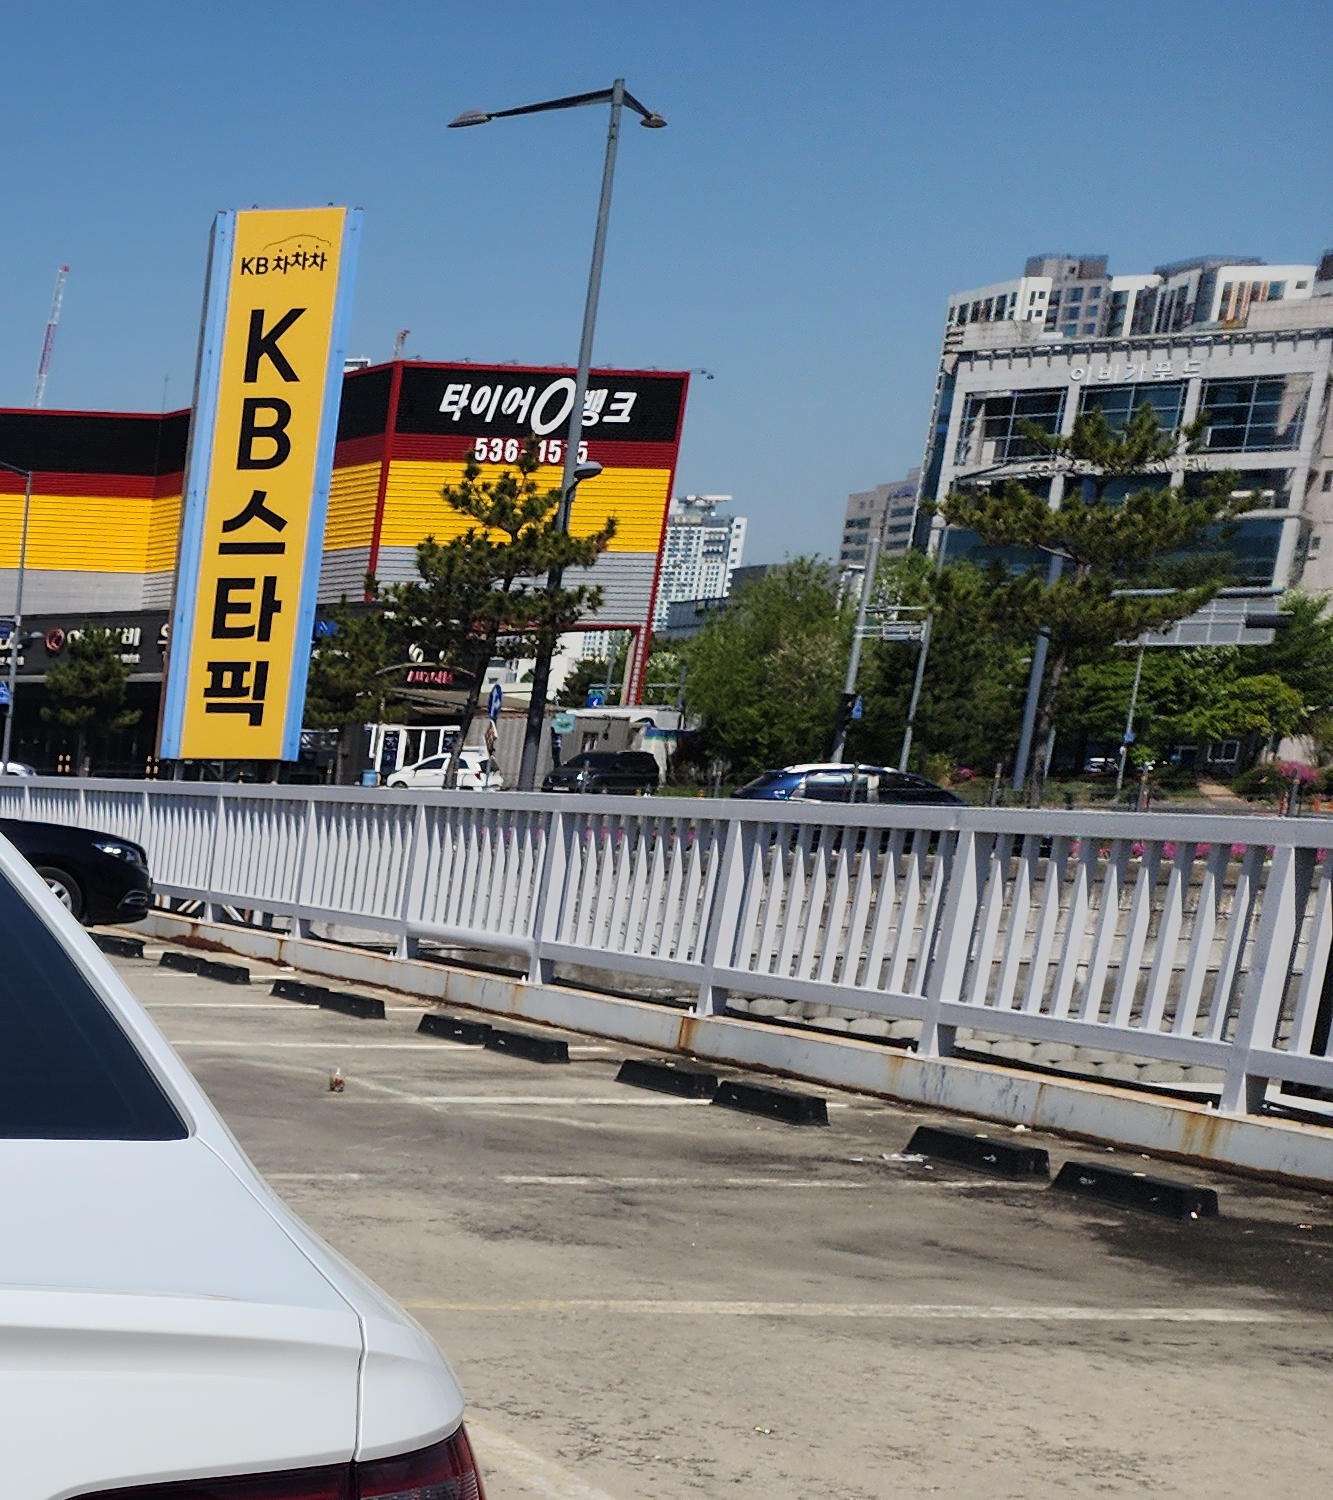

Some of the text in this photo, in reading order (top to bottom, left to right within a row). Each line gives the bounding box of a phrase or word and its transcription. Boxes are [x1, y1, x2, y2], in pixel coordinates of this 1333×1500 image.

[240, 244, 328, 276] KB 차차차
[474, 437, 589, 465] 536-155
